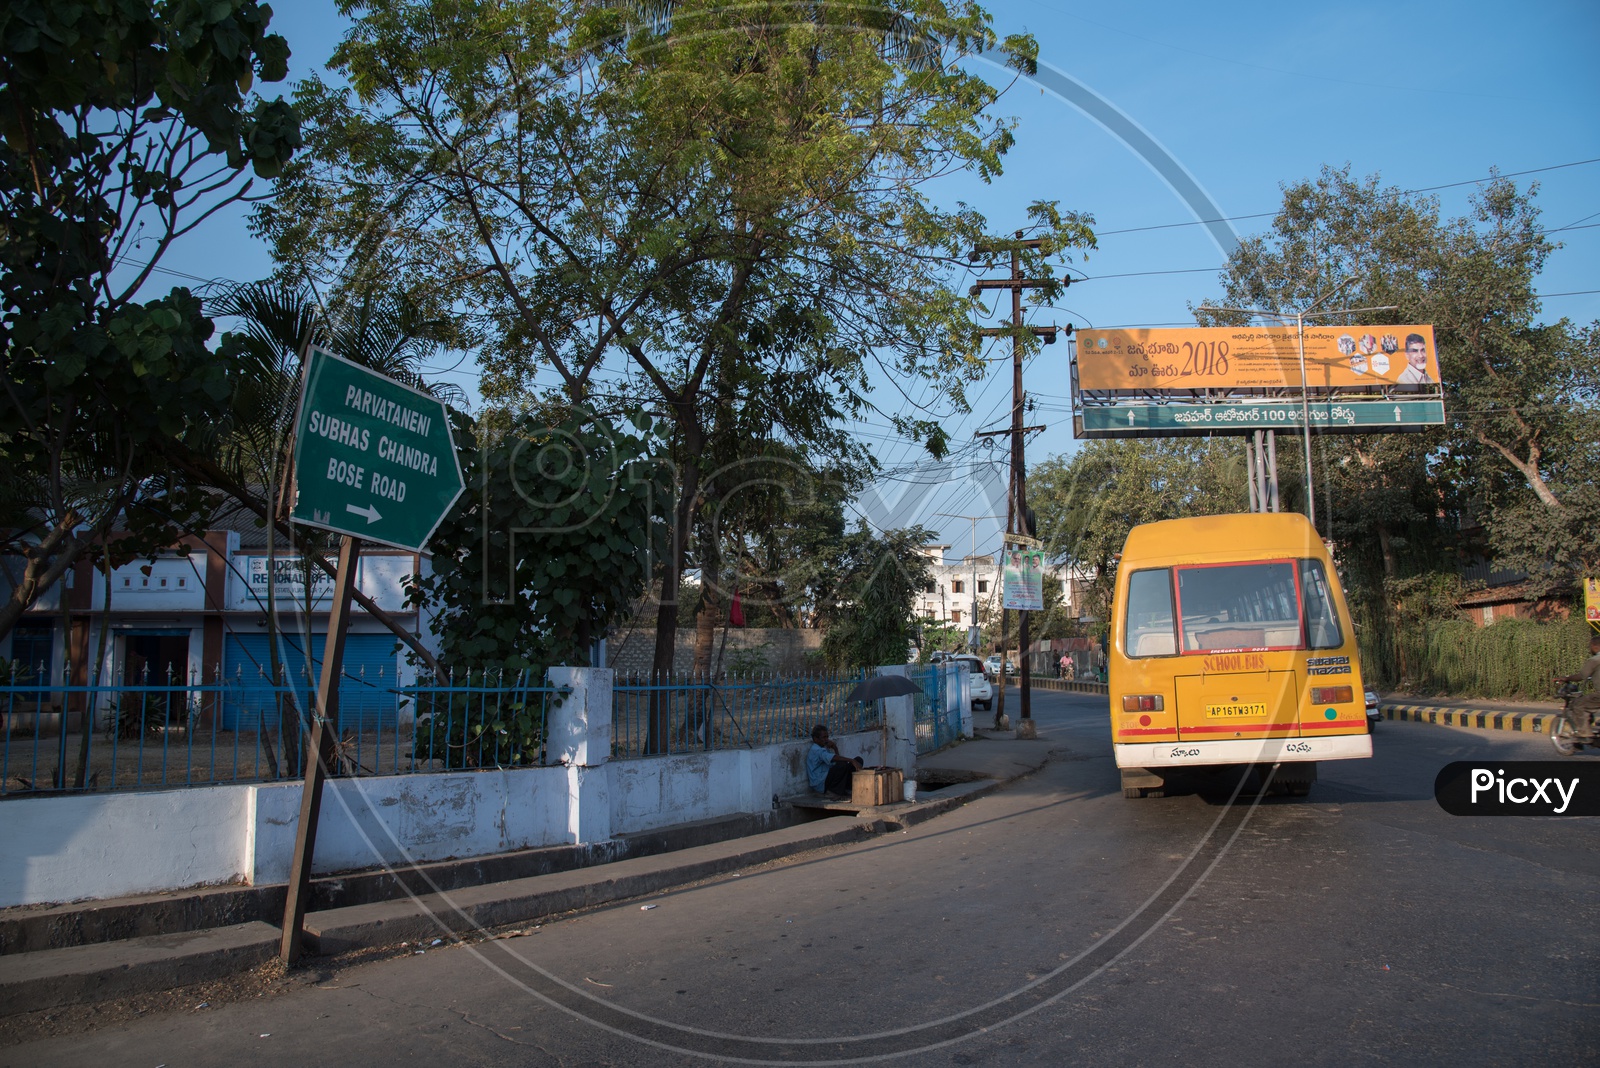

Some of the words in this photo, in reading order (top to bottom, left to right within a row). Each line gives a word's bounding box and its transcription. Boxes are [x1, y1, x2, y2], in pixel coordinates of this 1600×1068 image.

[1127, 341, 1179, 361] జన్మభూమి
[1180, 340, 1229, 376] 2018
[1129, 364, 1148, 377] మా
[1151, 364, 1178, 377] ఊరు
[345, 384, 432, 437] PARVATANENI
[1174, 408, 1213, 422] జవహర్
[1215, 407, 1260, 422] ఆటోనగర్
[1262, 409, 1285, 421] 100
[1331, 406, 1355, 425] రోడ్డు
[309, 410, 370, 451] SUBHAS
[378, 435, 438, 477] CHANDRA
[326, 457, 365, 489] BOSE
[371, 472, 407, 503] ROAD
[253, 573, 304, 584] REIONAL
[1204, 655, 1242, 671] SCHOOL
[1245, 653, 1265, 670] BUS
[1211, 705, 1265, 717] AP16TW3171
